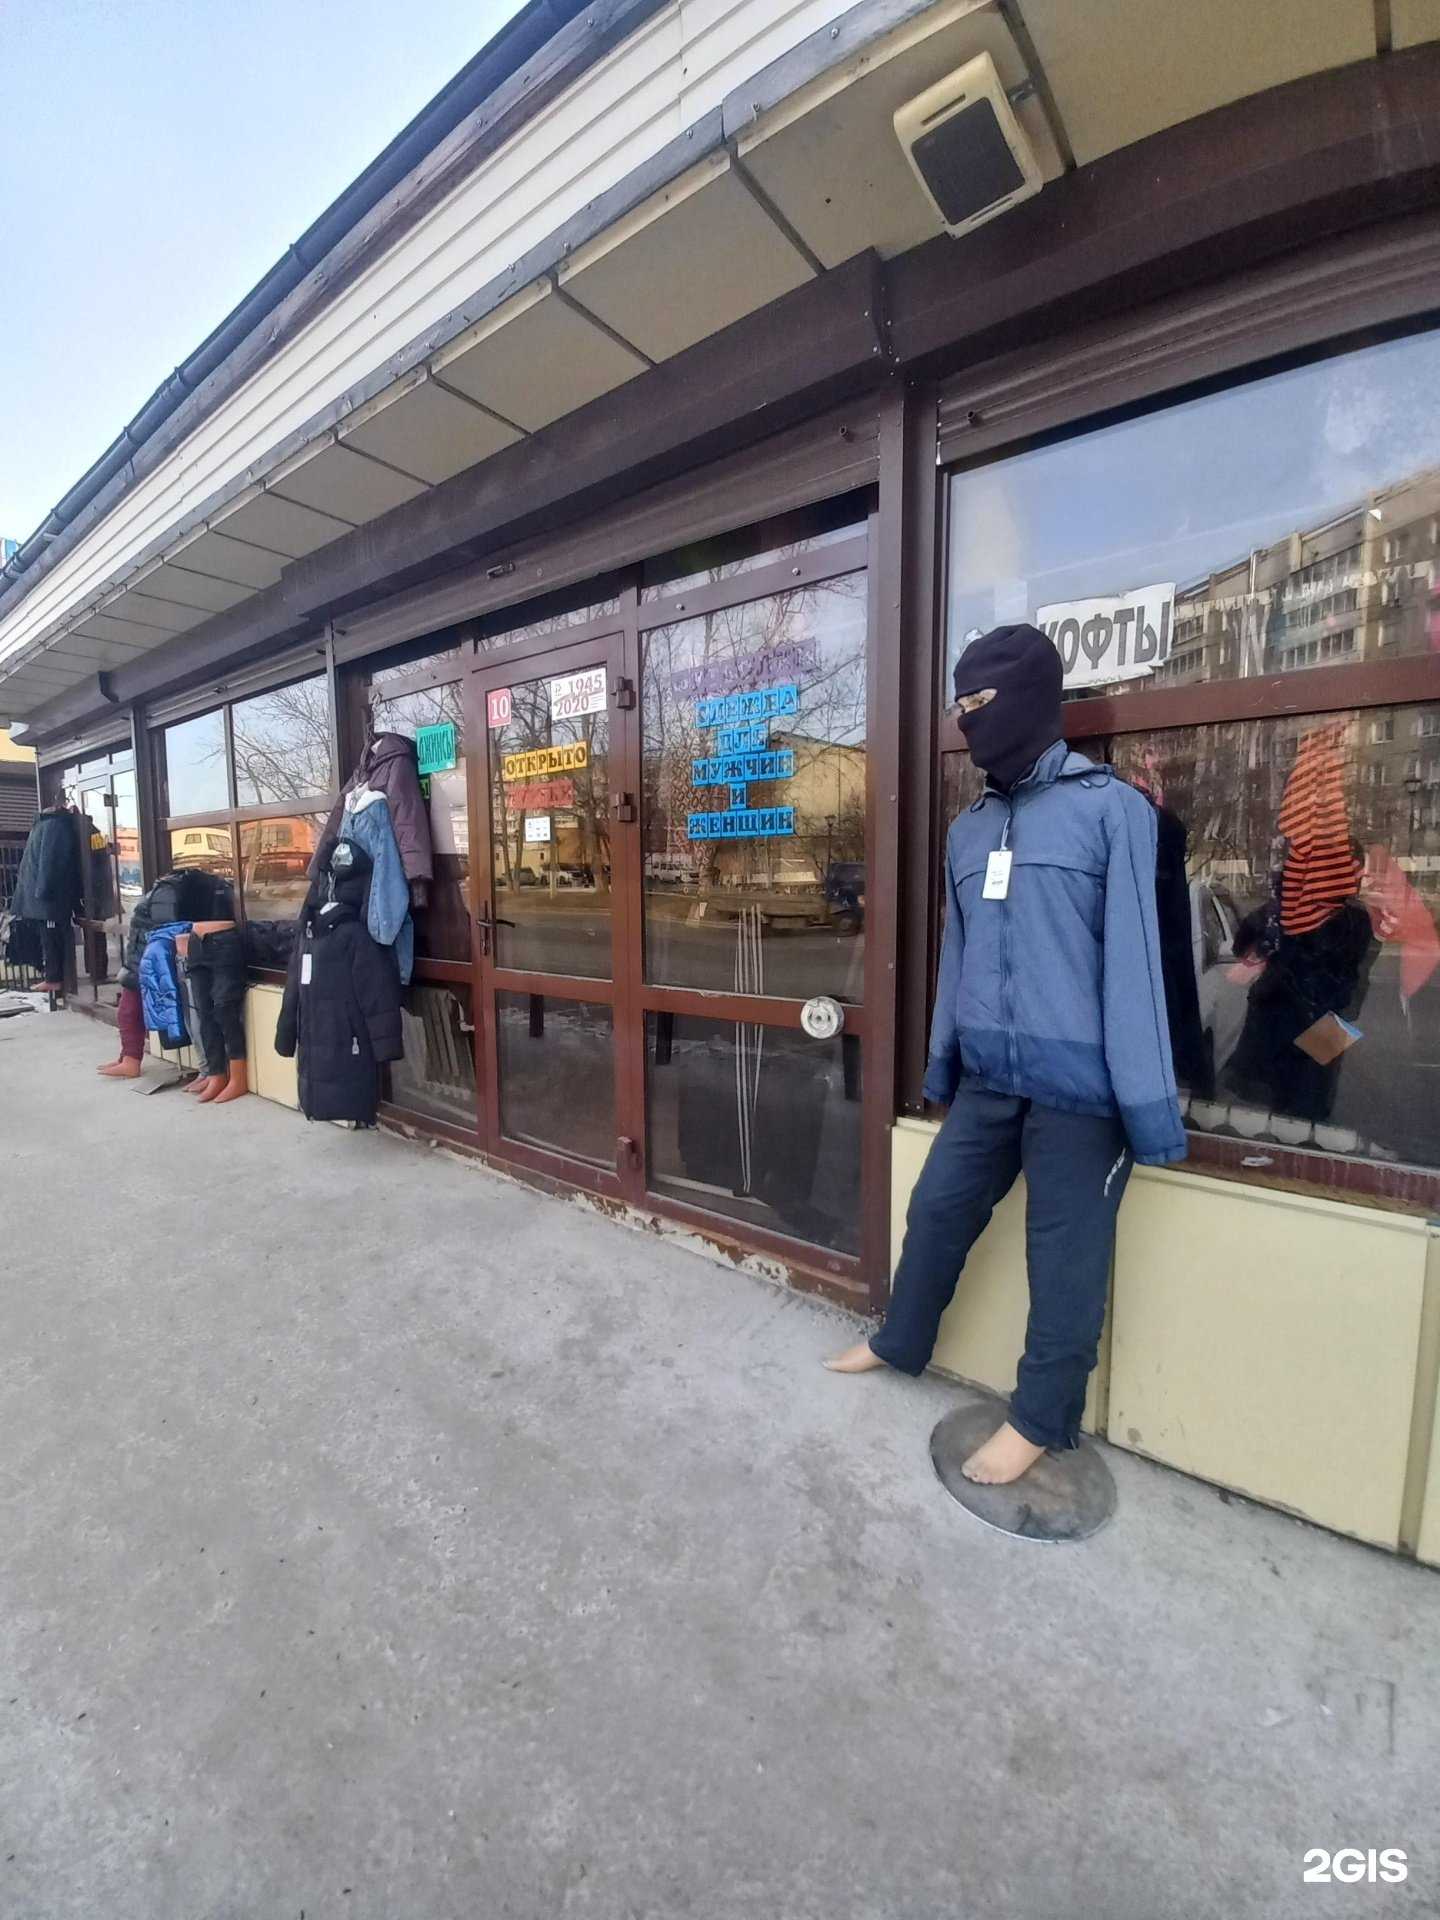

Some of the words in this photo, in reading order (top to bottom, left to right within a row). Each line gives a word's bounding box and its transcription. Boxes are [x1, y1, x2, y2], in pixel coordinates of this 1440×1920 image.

[569, 674, 603, 697] 1945
[492, 695, 509, 720] 10
[555, 693, 589, 716] 2020
[506, 746, 586, 775] ОТКРЫТО
[694, 754, 793, 781] МУЖЧИН
[732, 787, 745, 805] И
[689, 811, 793, 835] ЖЕНЩИН
